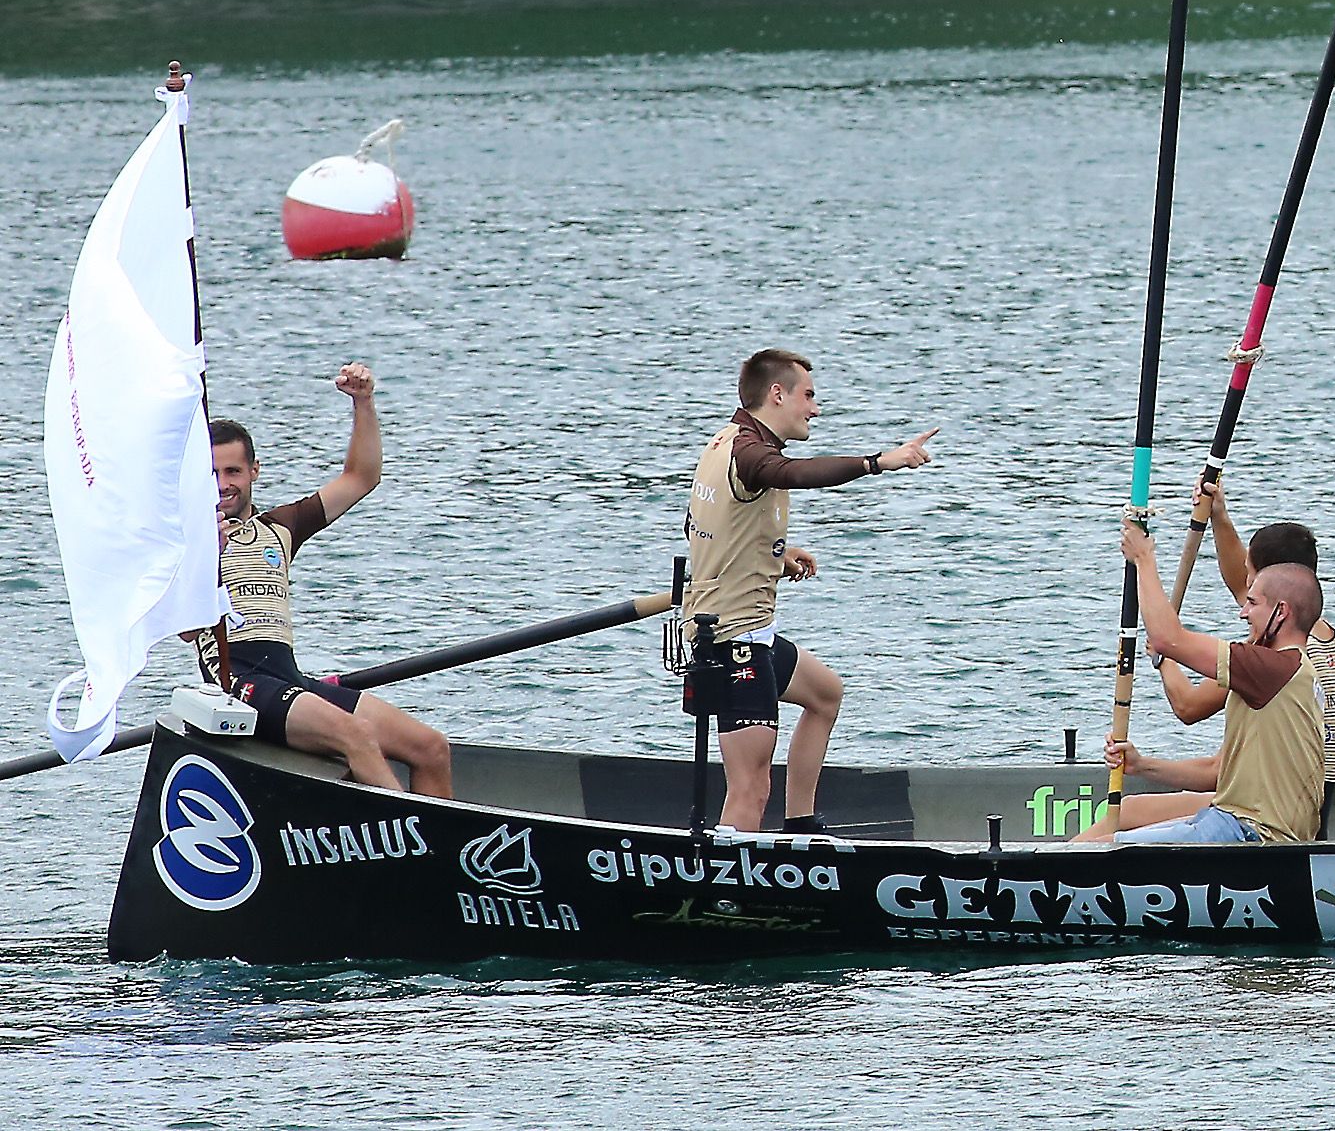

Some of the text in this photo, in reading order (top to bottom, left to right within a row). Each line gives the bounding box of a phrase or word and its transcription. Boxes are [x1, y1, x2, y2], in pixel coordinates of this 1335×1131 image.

[587, 838, 841, 891] gipuzkoa
[457, 891, 581, 931] BATELA
[876, 874, 1279, 929] GETARIA
